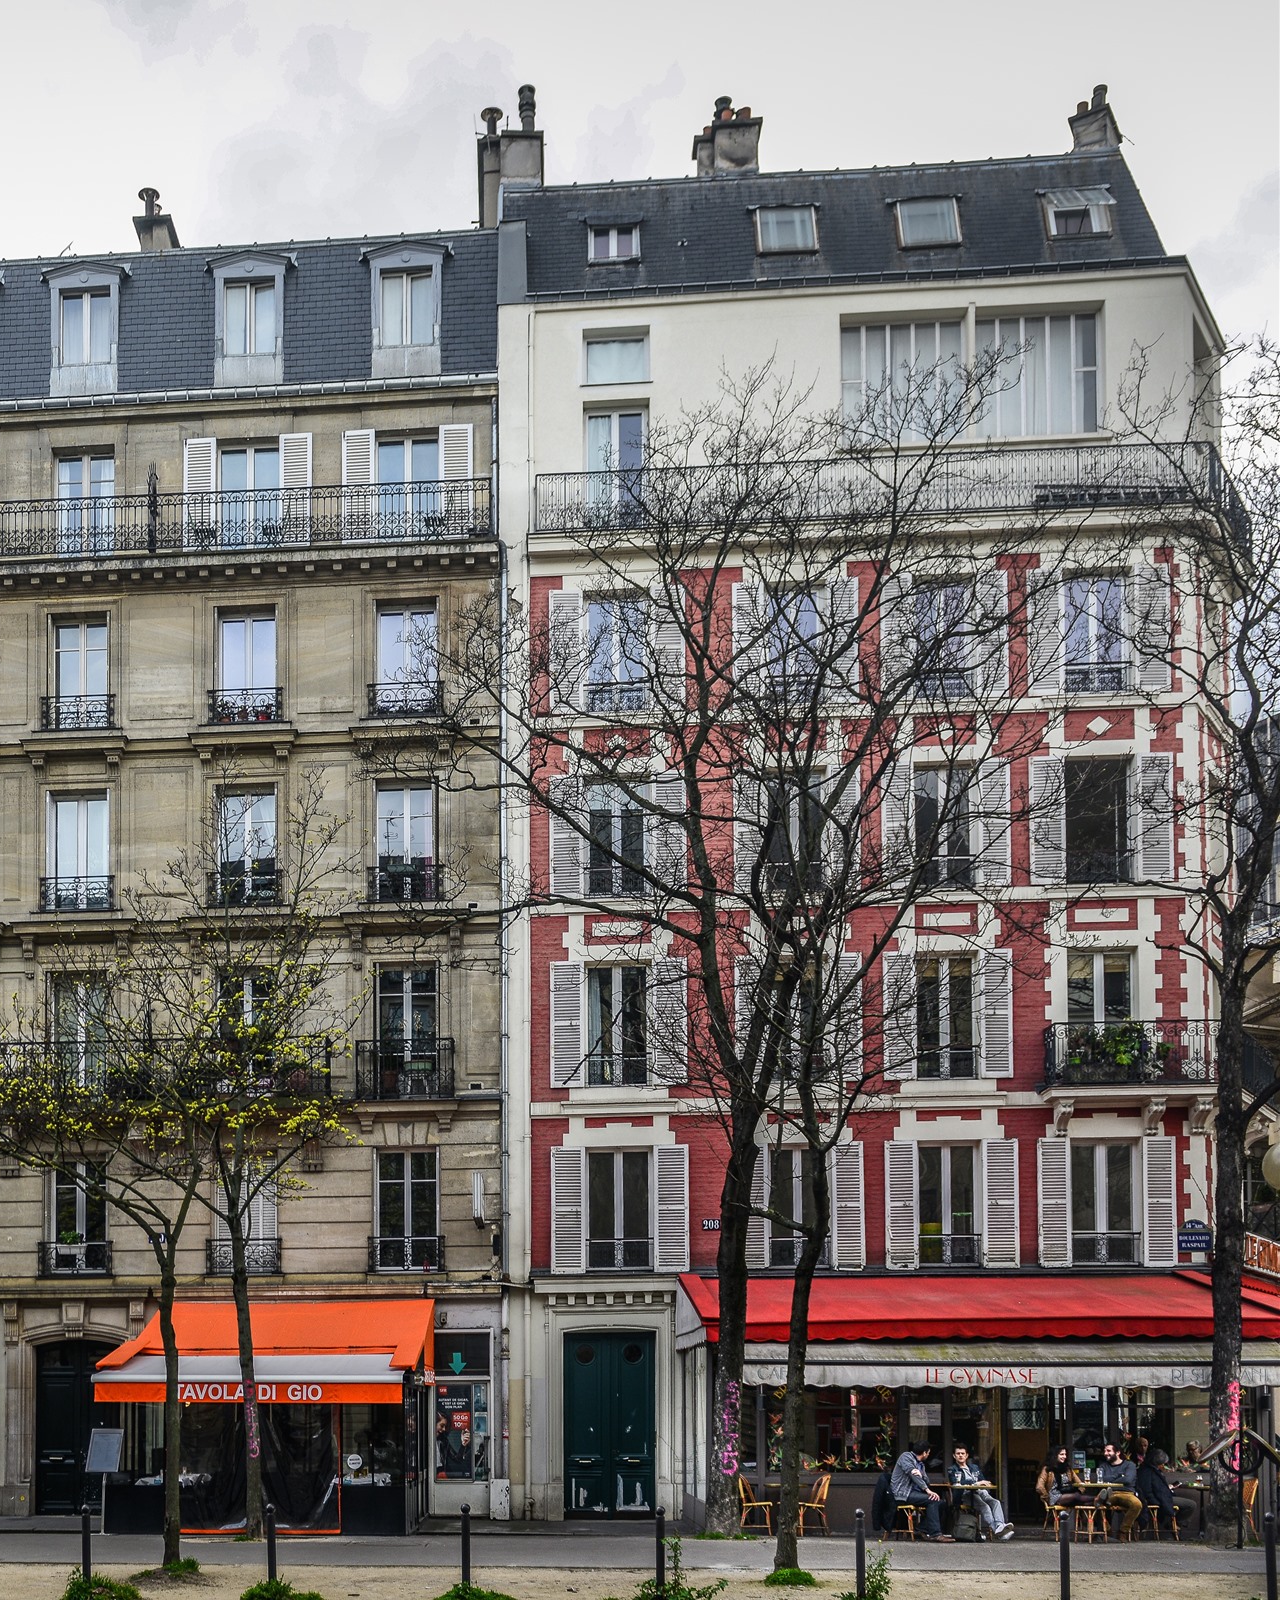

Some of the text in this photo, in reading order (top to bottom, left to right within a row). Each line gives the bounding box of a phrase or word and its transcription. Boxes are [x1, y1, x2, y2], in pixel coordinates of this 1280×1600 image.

[702, 1219, 720, 1230] 208
[757, 1367, 788, 1380] CAF
[925, 1368, 1038, 1384] LE GYMNASE
[1171, 1368, 1270, 1383] RESTANT
[177, 1384, 323, 1400] TAVOLA DI GIO
